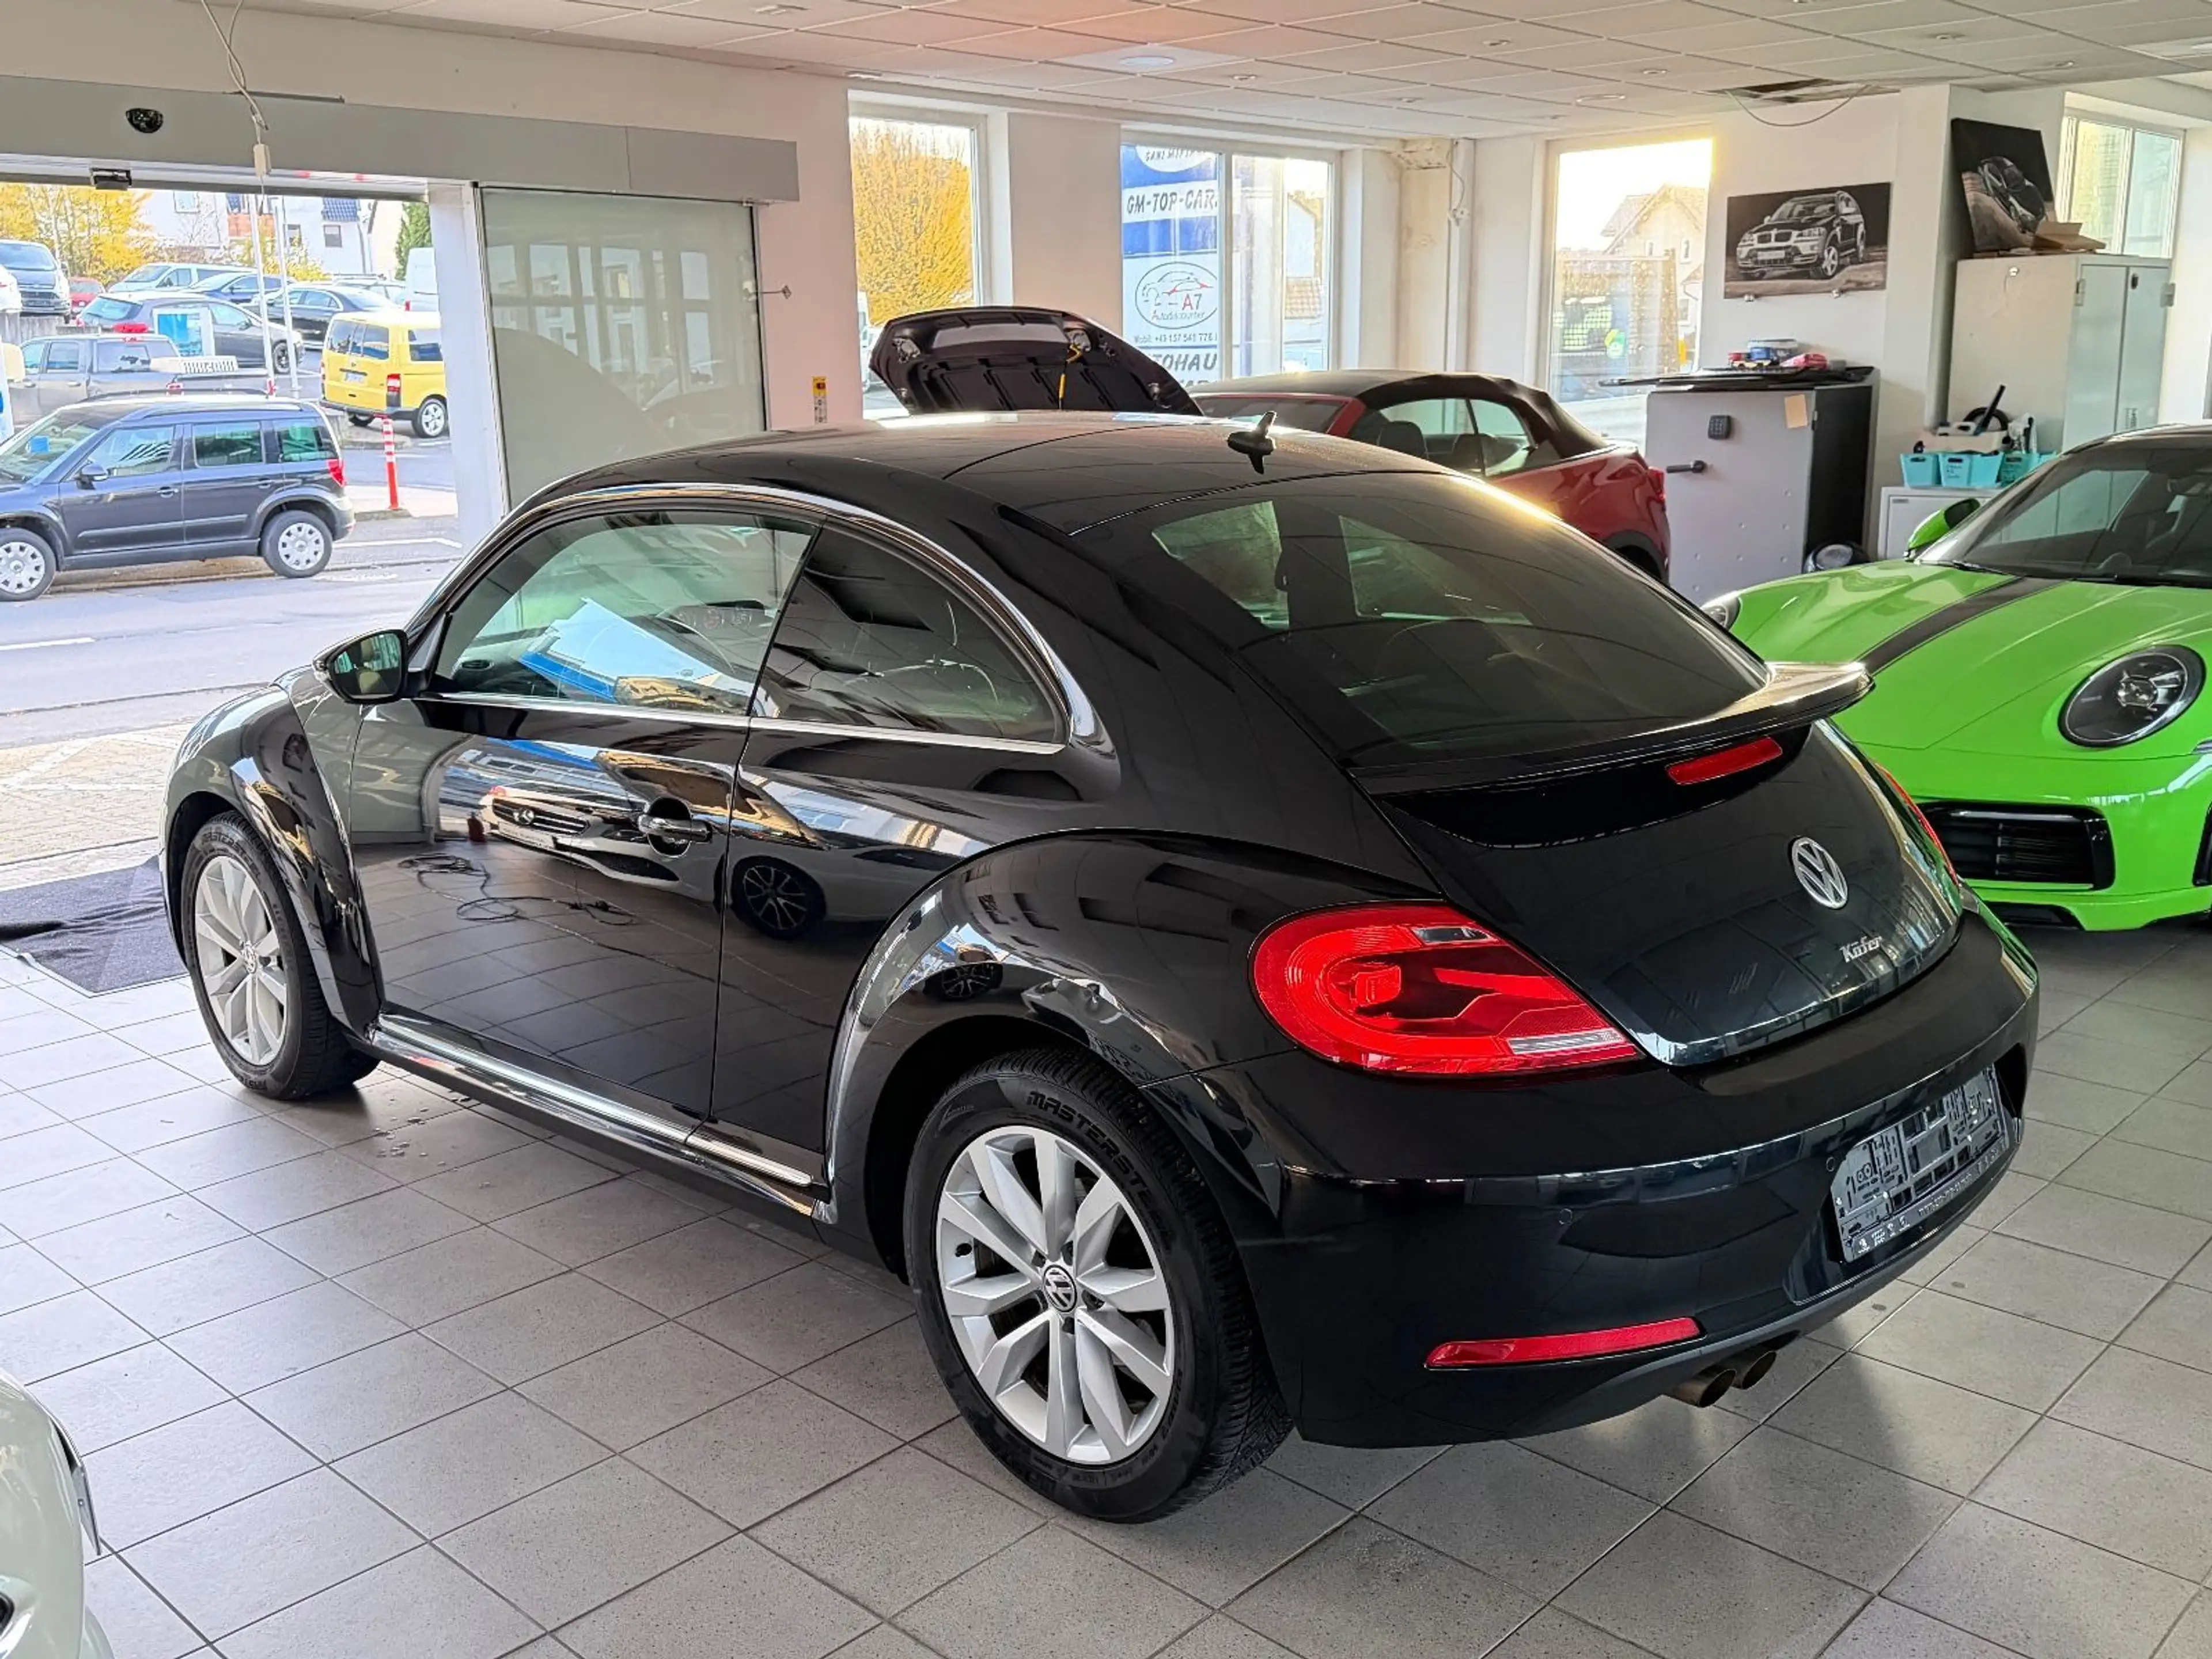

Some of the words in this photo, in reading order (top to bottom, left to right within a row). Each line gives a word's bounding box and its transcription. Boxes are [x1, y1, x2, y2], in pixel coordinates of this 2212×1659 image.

[1127, 189, 1218, 214] GM-TOP-CAR
[1182, 293, 1202, 310] A7
[1839, 935, 1883, 963] Käfer
